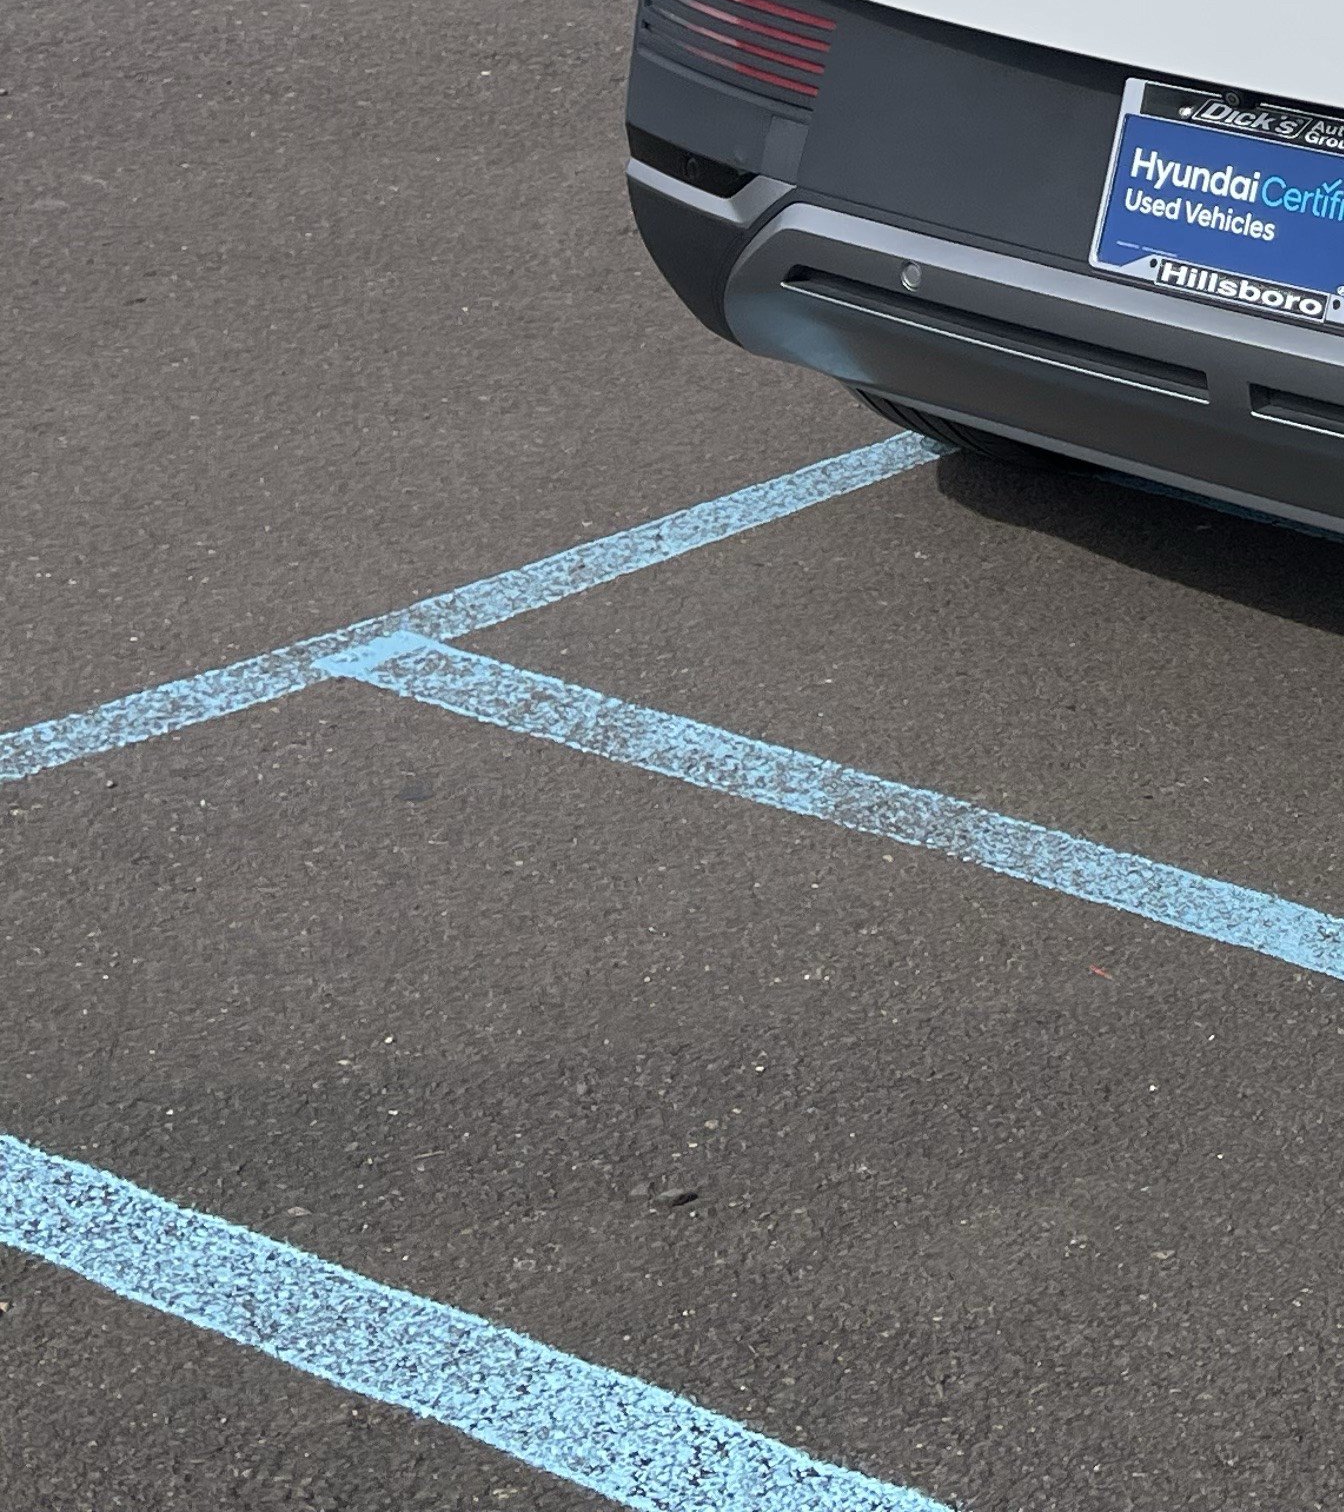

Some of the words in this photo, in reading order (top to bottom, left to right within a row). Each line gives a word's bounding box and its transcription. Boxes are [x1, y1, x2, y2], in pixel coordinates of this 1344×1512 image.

[1200, 101, 1298, 136] Dick's
[1130, 147, 1261, 203] Hyundai
[1125, 188, 1181, 220] Used
[1186, 201, 1276, 241] Vehicles
[1160, 262, 1323, 316] Hillsboro
